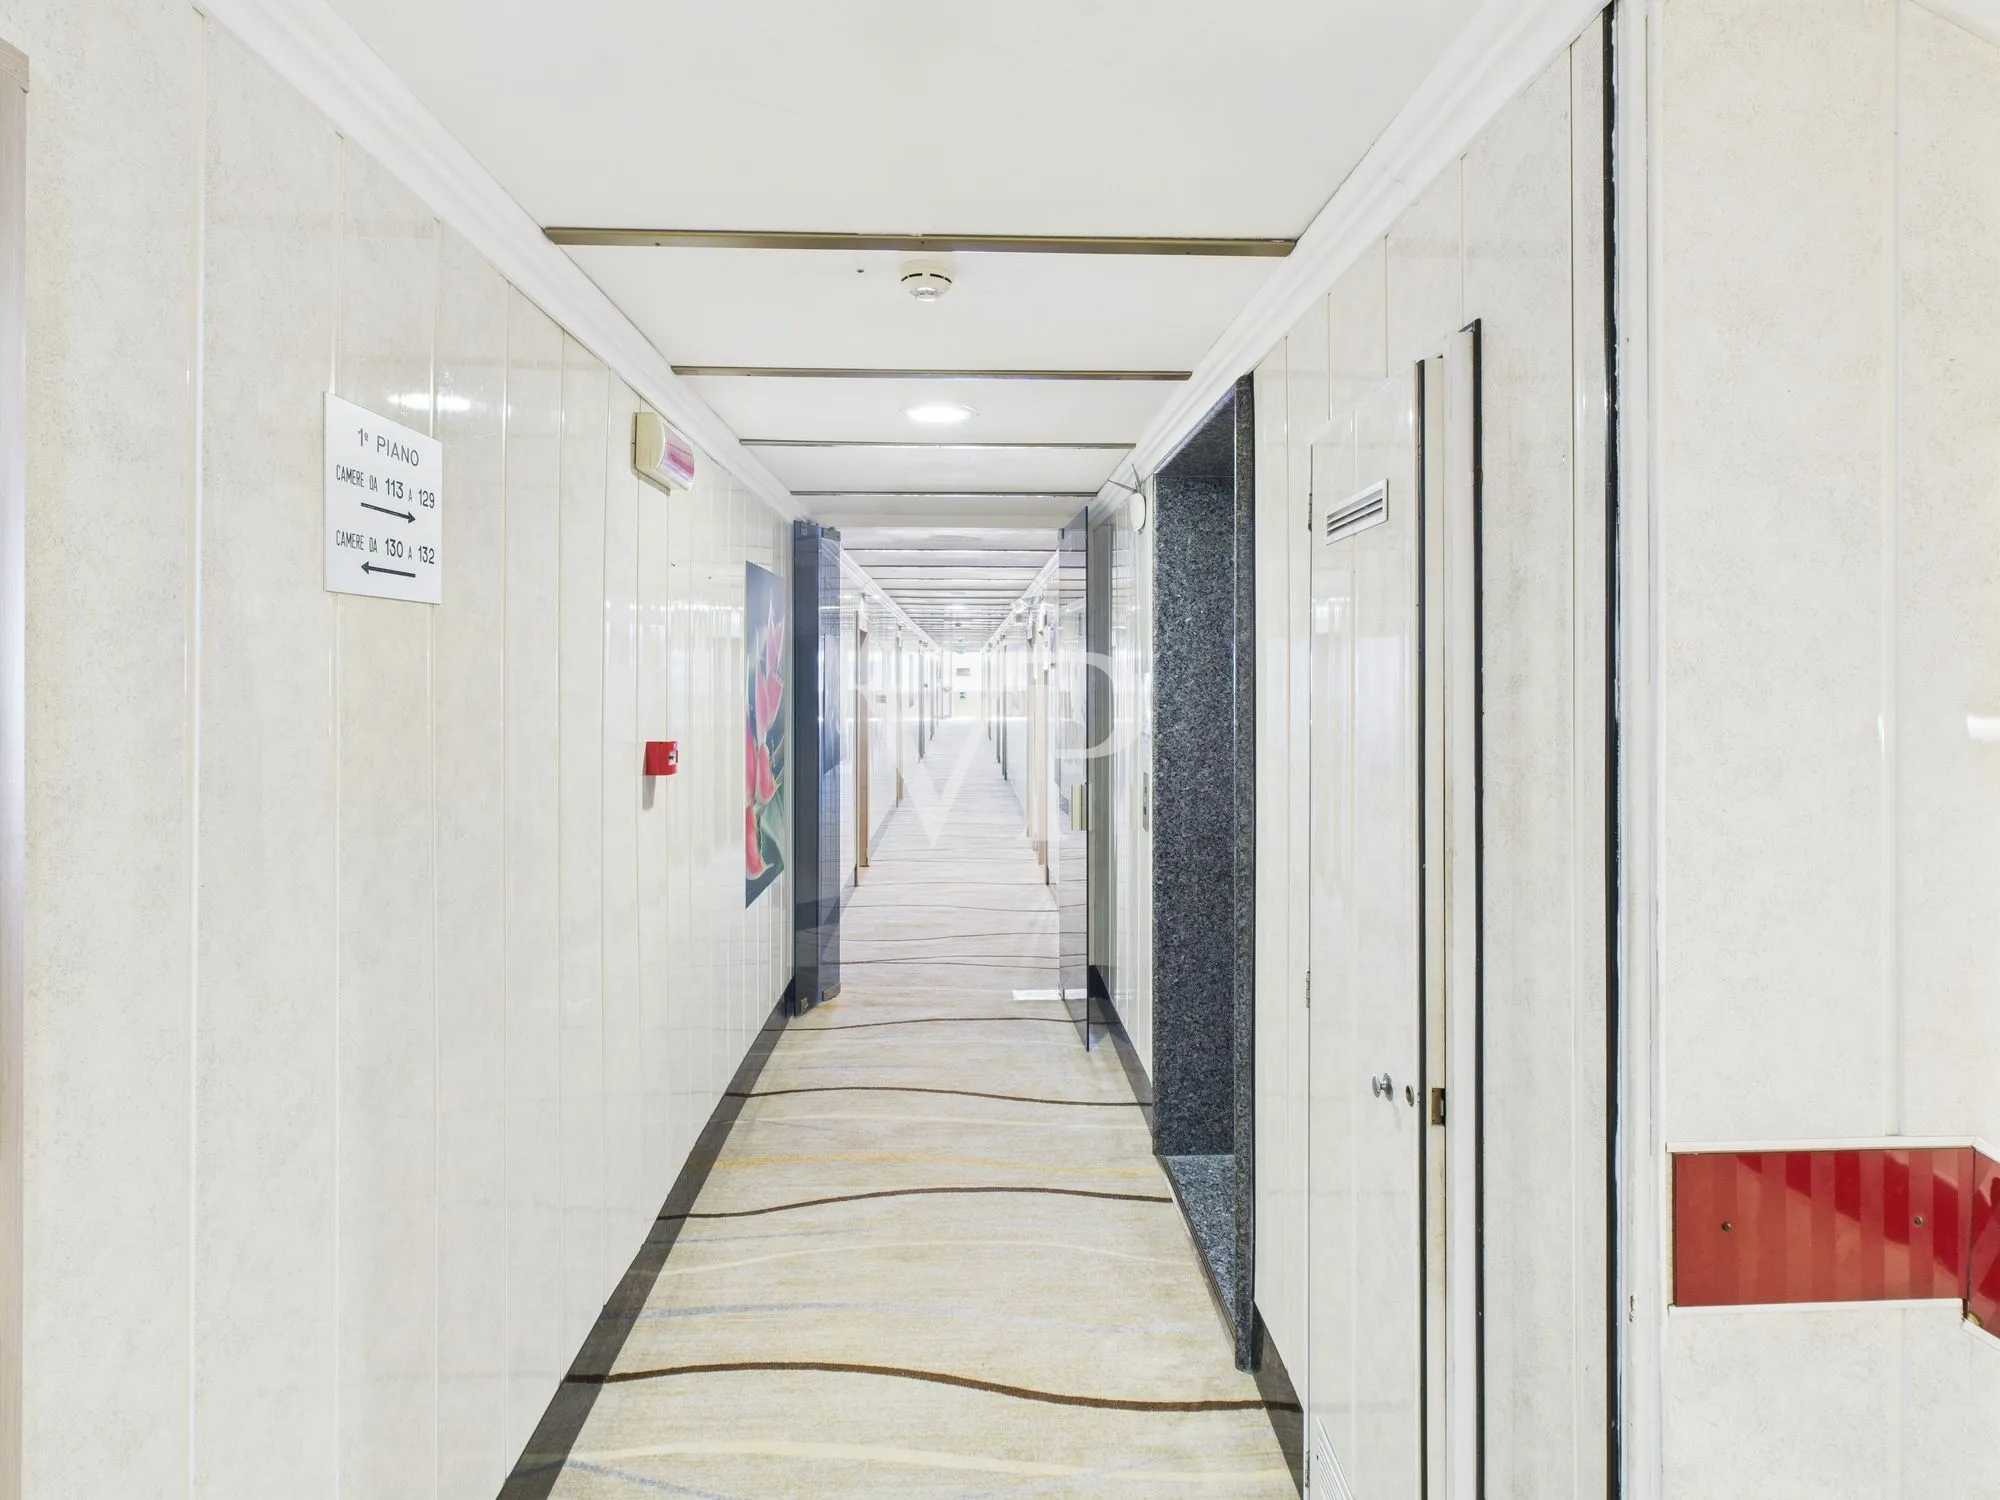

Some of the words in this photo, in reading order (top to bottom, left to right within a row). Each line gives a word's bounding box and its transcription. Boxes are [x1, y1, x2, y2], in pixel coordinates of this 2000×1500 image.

[376, 435, 420, 467] PIANO
[335, 464, 365, 489] CAMERE
[369, 475, 378, 491] DA
[385, 478, 404, 499] 113
[408, 489, 413, 502] A
[418, 490, 435, 509] 129
[335, 529, 365, 551] CAMERE
[369, 537, 378, 553] DA
[385, 538, 404, 558] 130
[408, 546, 413, 560] A
[418, 546, 435, 564] 132
